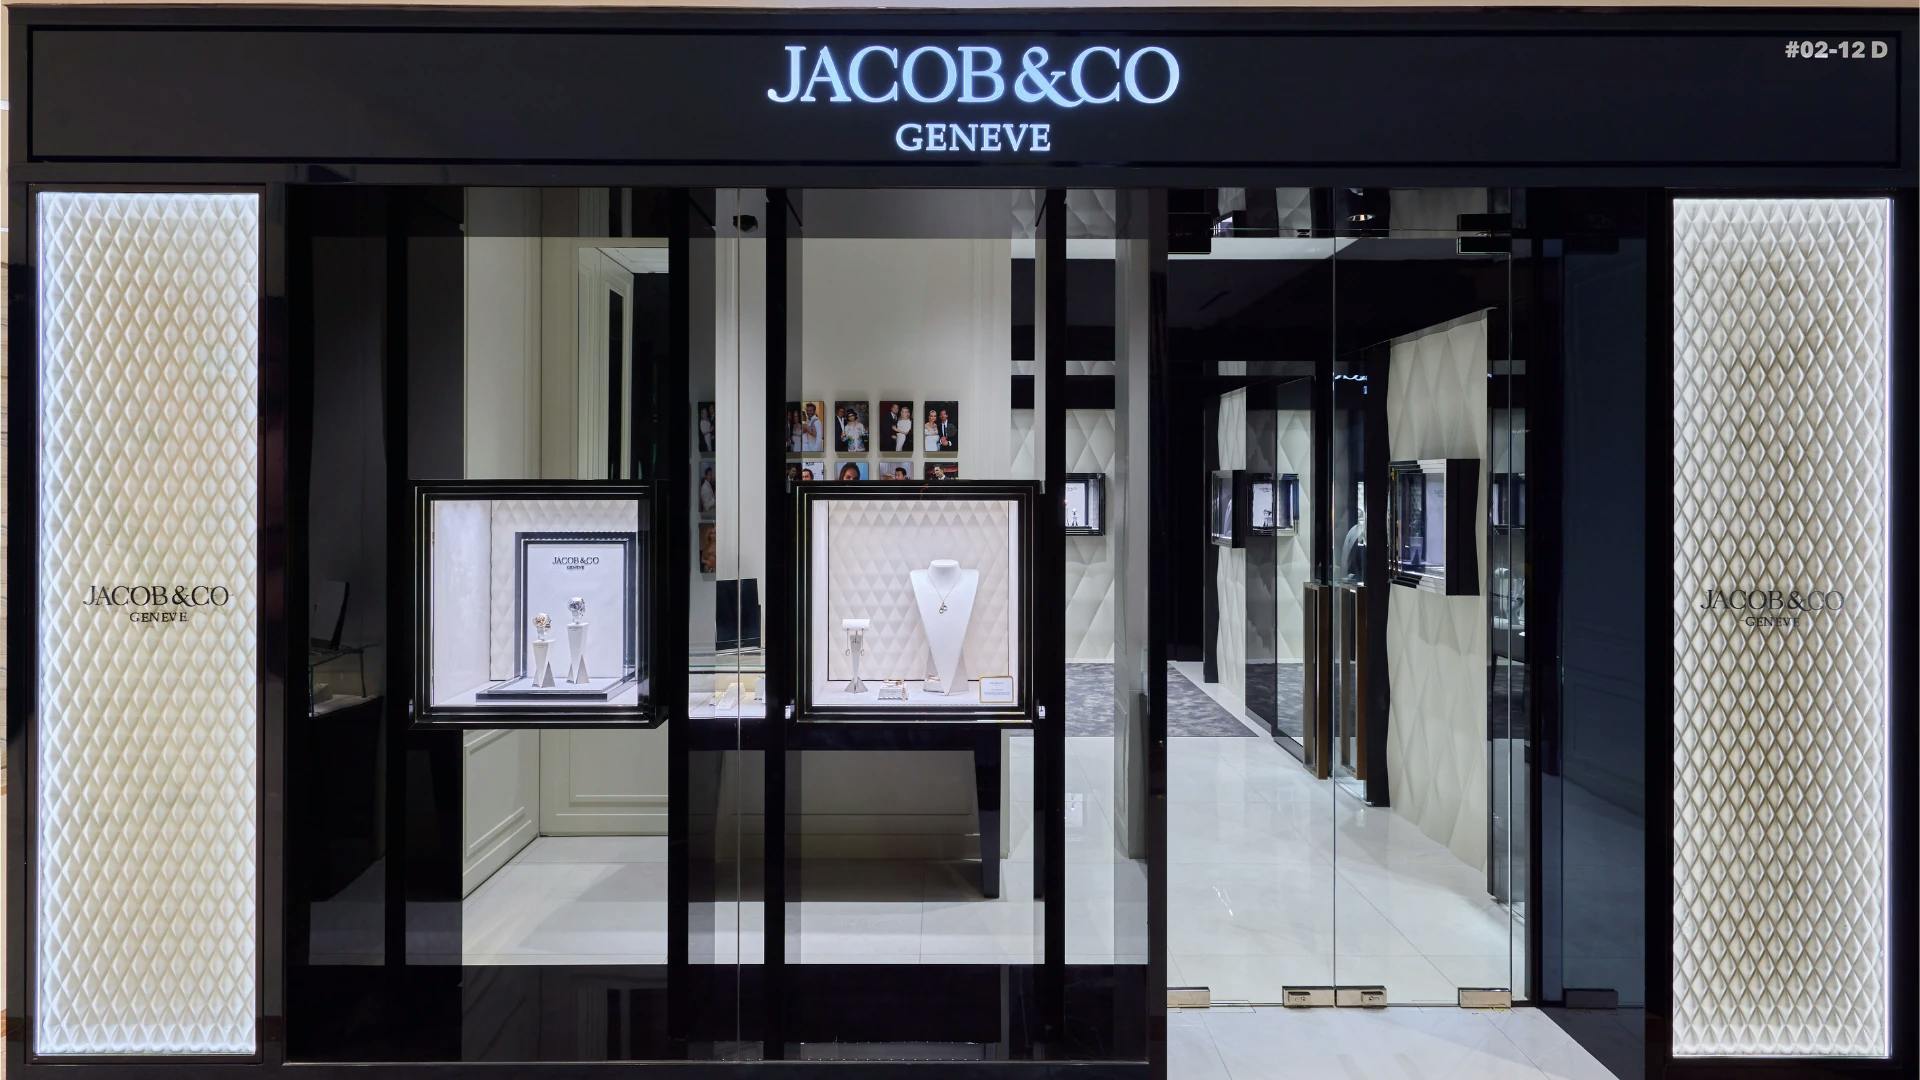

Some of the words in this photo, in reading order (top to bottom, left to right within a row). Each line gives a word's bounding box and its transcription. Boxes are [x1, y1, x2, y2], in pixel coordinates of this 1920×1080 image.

[1785, 40, 1866, 59] #02-12
[1871, 41, 1888, 58] D
[895, 123, 1051, 152] GENEVE
[129, 612, 189, 623] GENEVE
[1744, 616, 1801, 627] GENEVE
